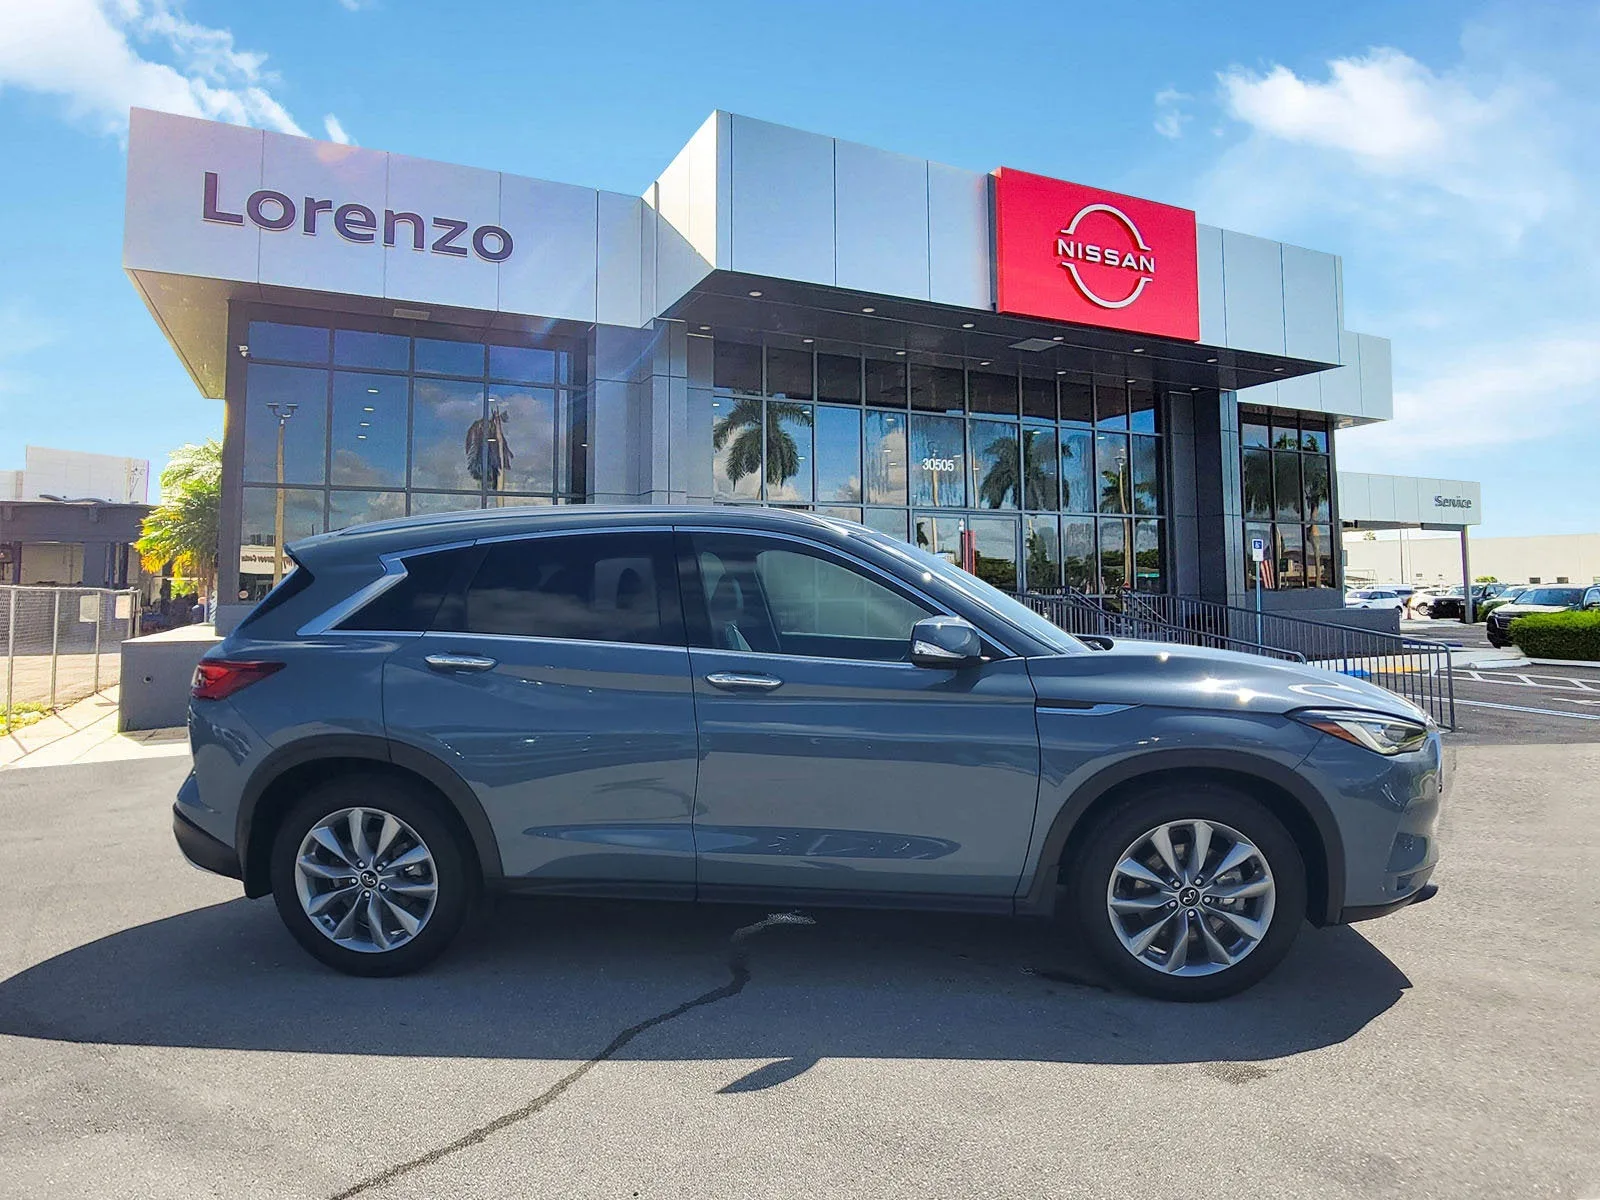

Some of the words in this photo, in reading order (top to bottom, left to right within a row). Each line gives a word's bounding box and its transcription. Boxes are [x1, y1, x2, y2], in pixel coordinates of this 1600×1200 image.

[202, 170, 515, 263] Lorenzo
[1057, 238, 1155, 273] NISSAN
[921, 458, 955, 472] 30505
[1434, 495, 1472, 508] Service
